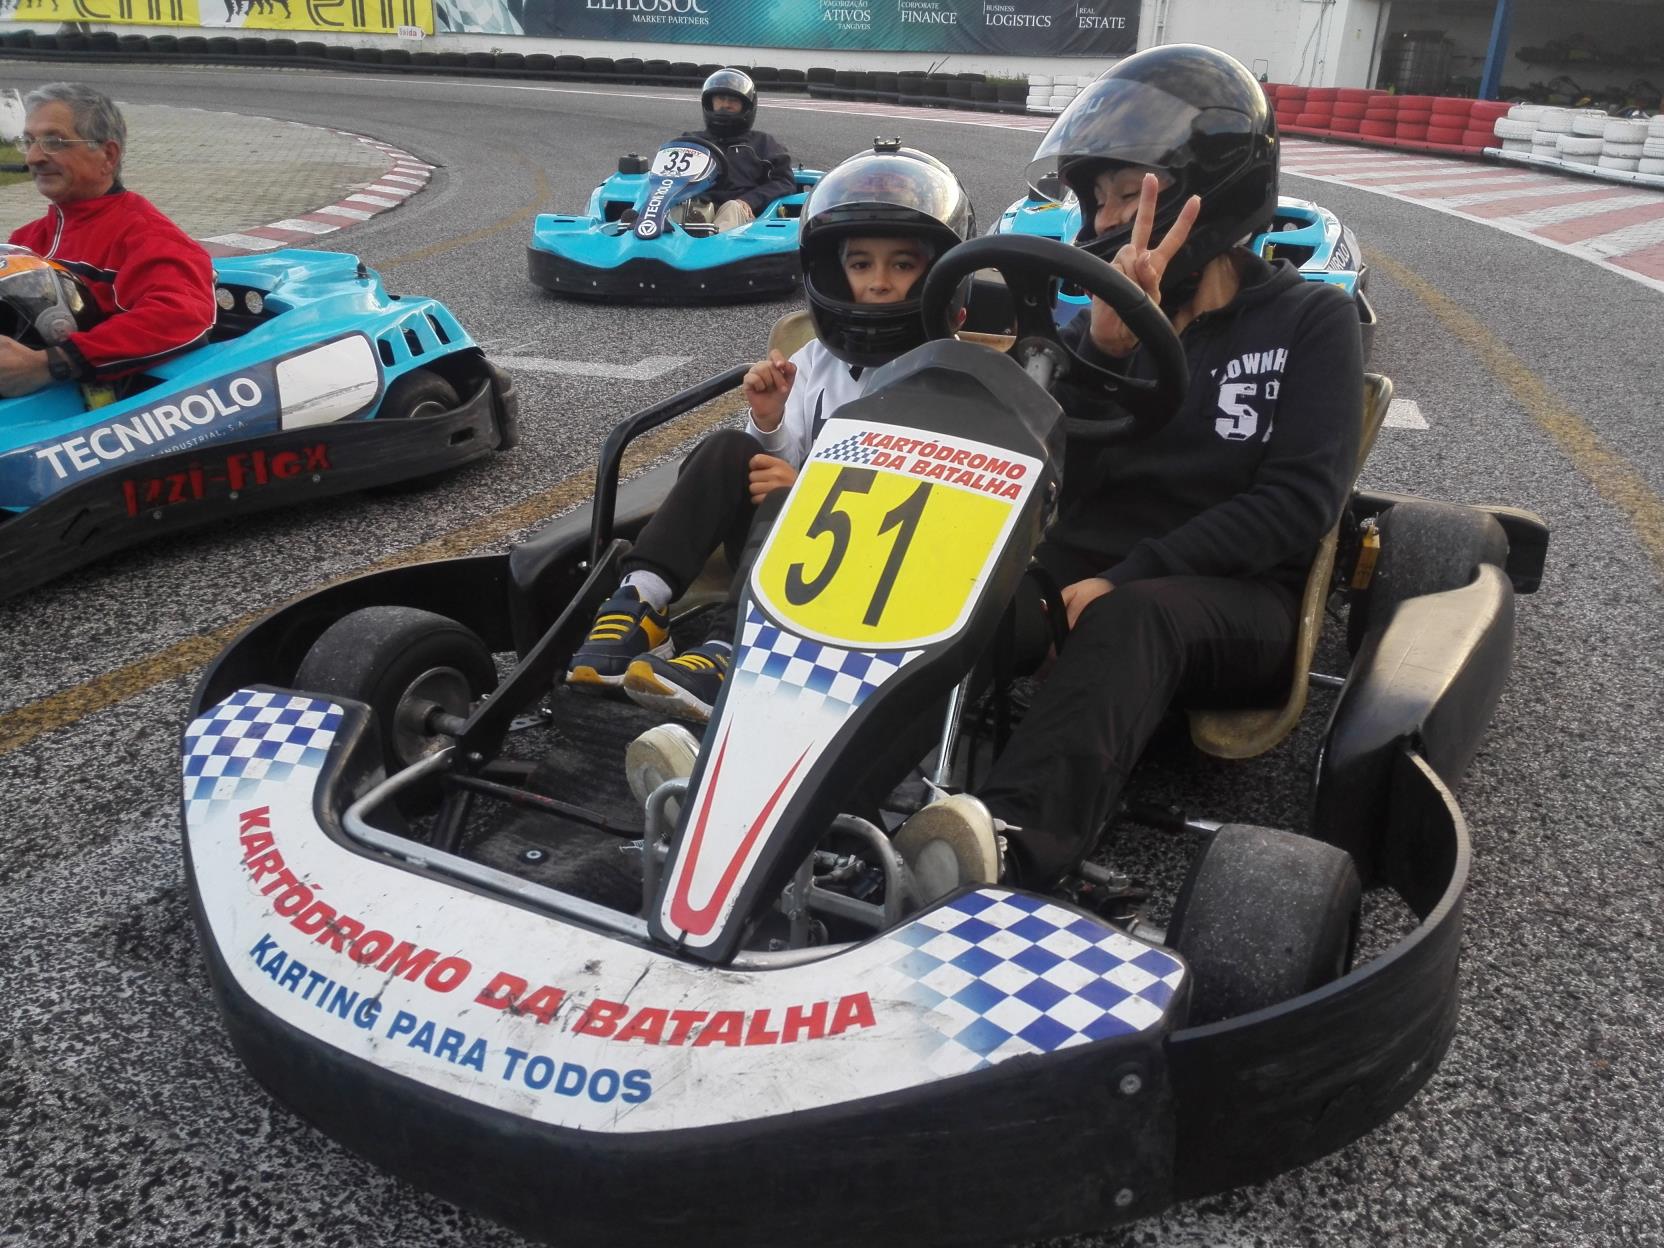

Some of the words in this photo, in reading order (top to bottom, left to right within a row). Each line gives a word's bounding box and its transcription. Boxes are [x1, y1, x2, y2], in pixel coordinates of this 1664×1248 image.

[823, 9, 872, 22] ATIVOS
[901, 10, 958, 25] FINANCE
[985, 4, 1016, 12] BUSINESS
[1078, 7, 1096, 15] REAL
[632, 14, 667, 24] MARKET
[668, 15, 710, 26] PARTNERS
[985, 13, 1052, 28] LOGISTICS
[1078, 16, 1127, 29] ESTATE
[663, 150, 694, 173] 35
[36, 376, 263, 479] TECNIROLO
[860, 431, 1028, 481] KARTÓDROMO
[870, 451, 902, 469] DA
[908, 460, 1023, 501] BATALHA
[784, 466, 934, 628] 51
[239, 805, 472, 993] KARTÓDROMO
[474, 971, 567, 1025] DA
[571, 991, 877, 1048] BATALHA
[248, 933, 383, 1031] KARTING
[385, 1009, 486, 1073] PARA
[502, 1047, 653, 1105] TODOS
